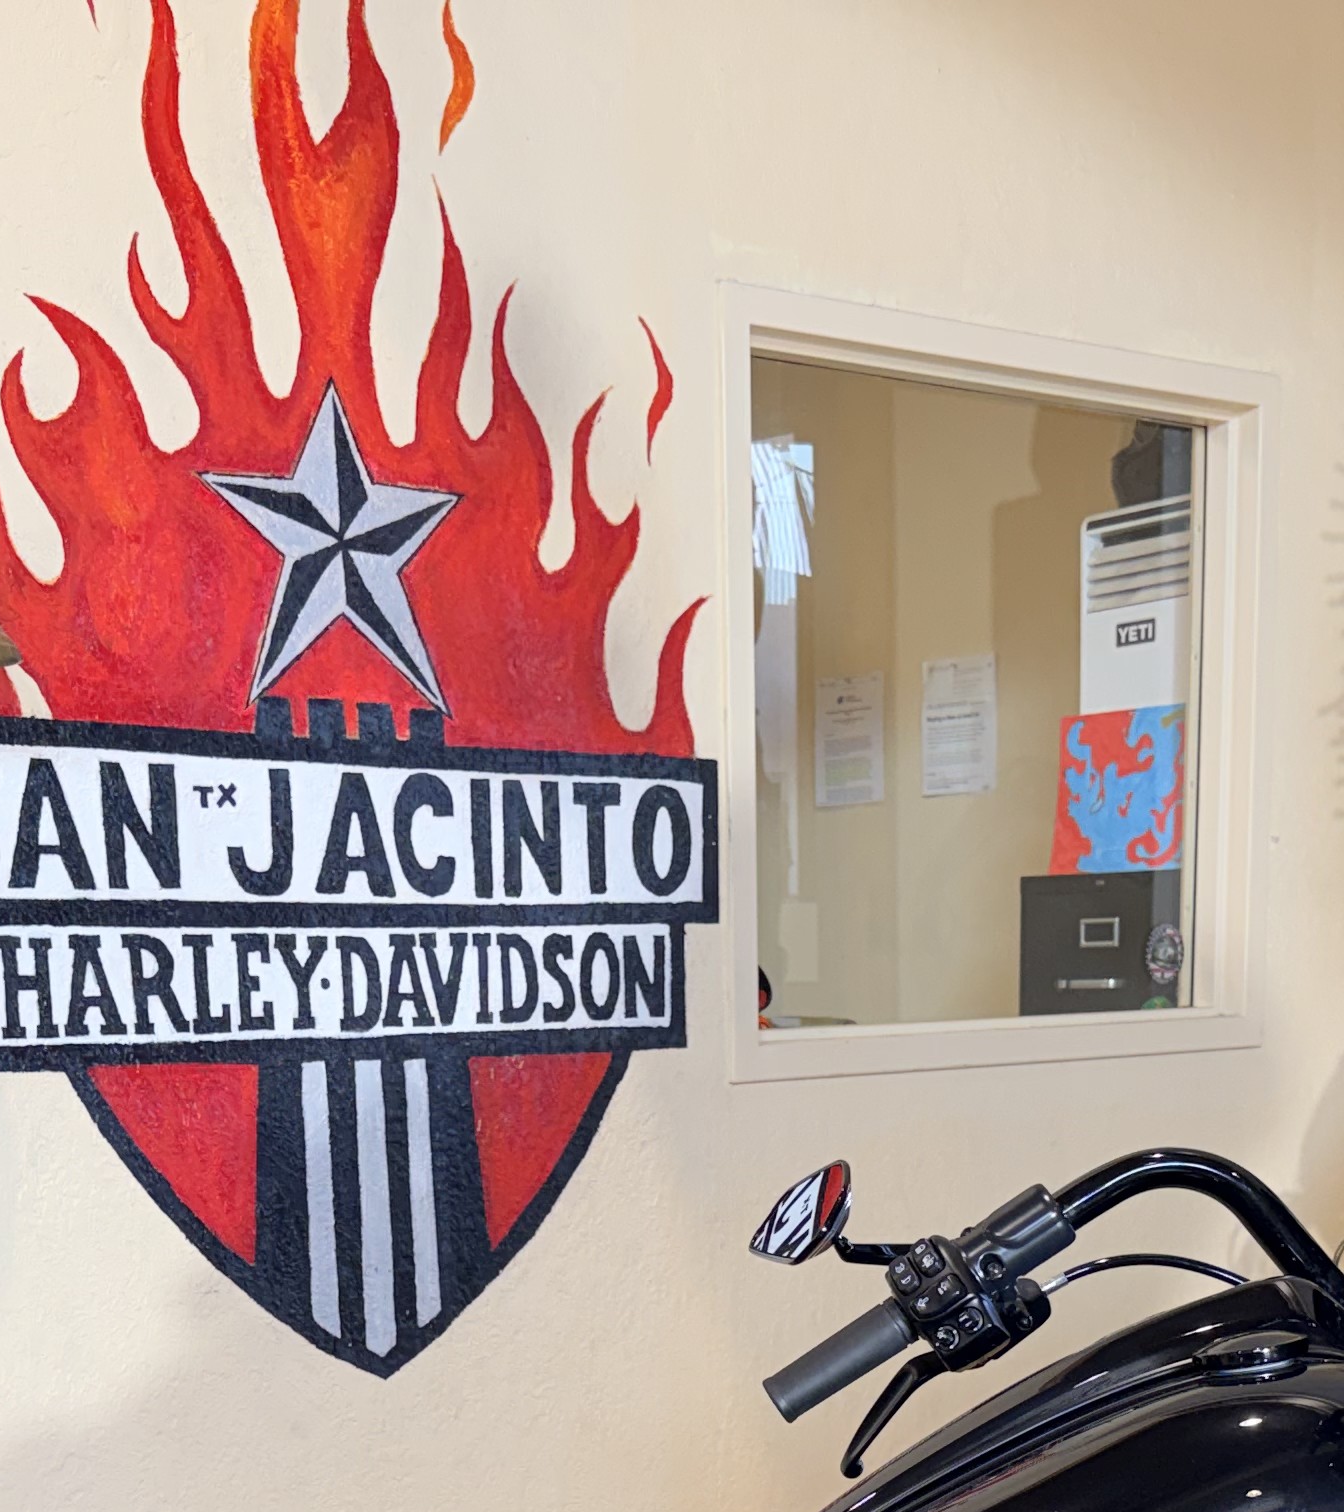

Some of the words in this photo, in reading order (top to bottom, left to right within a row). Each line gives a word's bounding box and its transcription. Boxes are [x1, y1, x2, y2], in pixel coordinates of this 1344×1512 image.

[1118, 623, 1153, 643] YETI
[193, 783, 237, 808] TX
[227, 767, 692, 898] JACINTO
